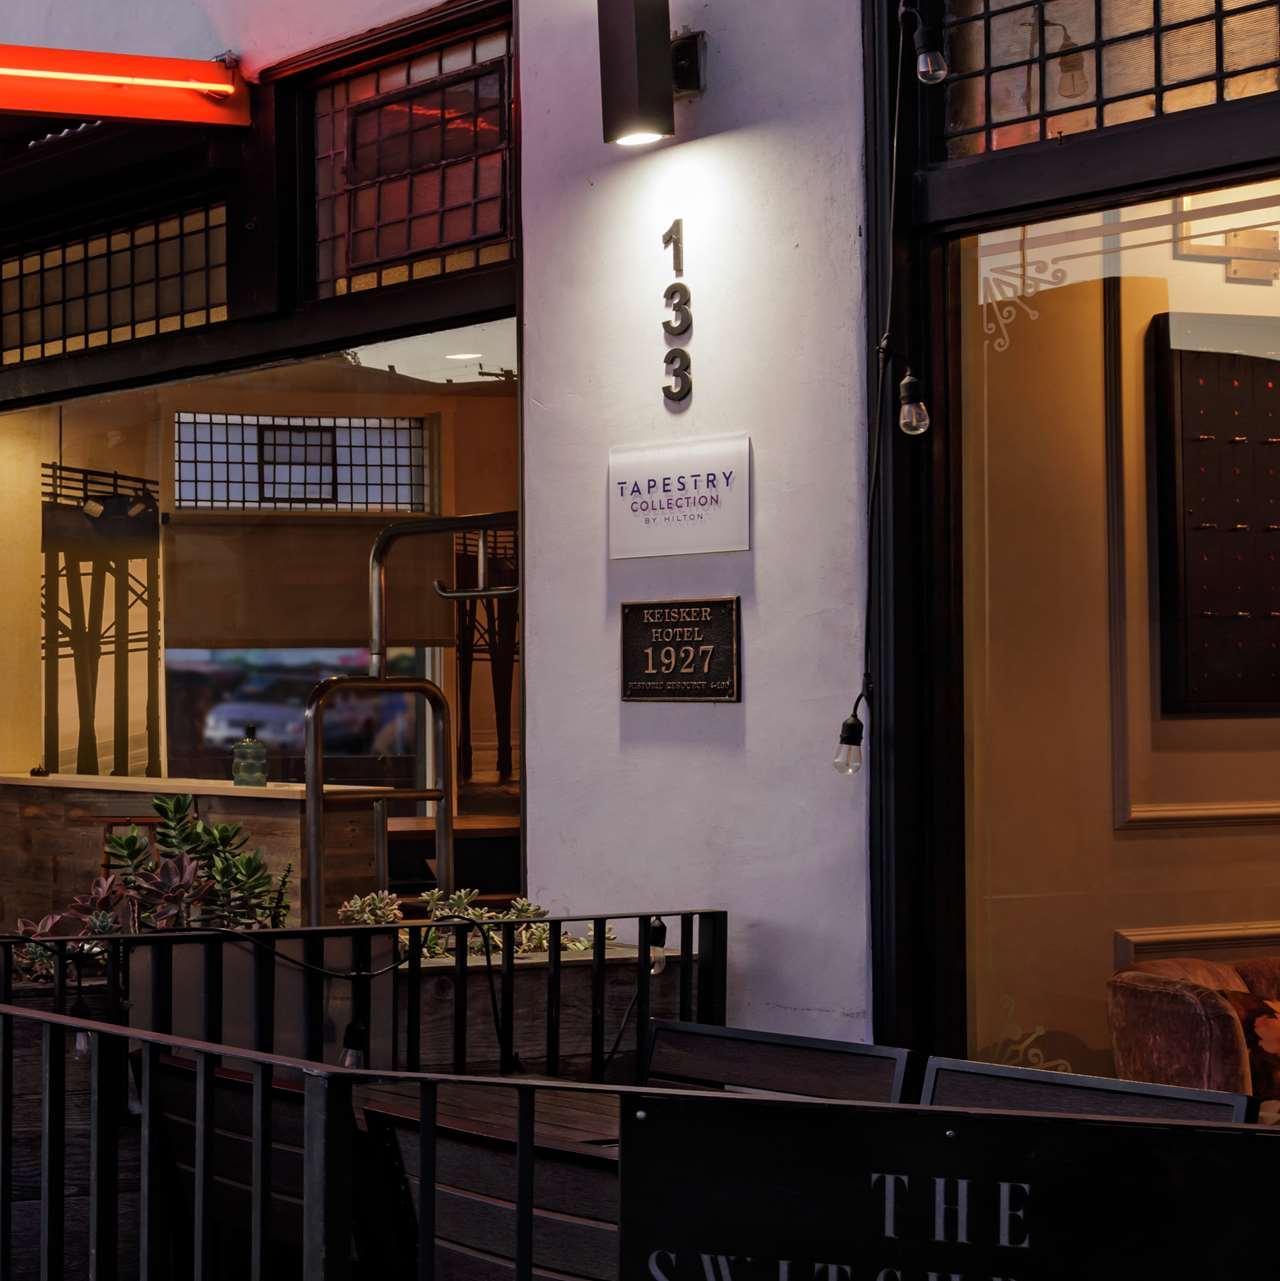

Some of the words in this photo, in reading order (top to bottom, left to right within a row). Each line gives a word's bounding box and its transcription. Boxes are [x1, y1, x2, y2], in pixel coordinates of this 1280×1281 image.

[662, 218, 693, 402] 133
[617, 470, 733, 497] TAPESTRY
[630, 494, 719, 513] COLLECTION
[644, 516, 657, 525] BY
[664, 513, 704, 522] HILTON
[643, 607, 712, 622] KEISKER
[651, 627, 704, 641] HOTEL
[643, 645, 714, 673] 1927
[870, 1172, 1031, 1248] THE
